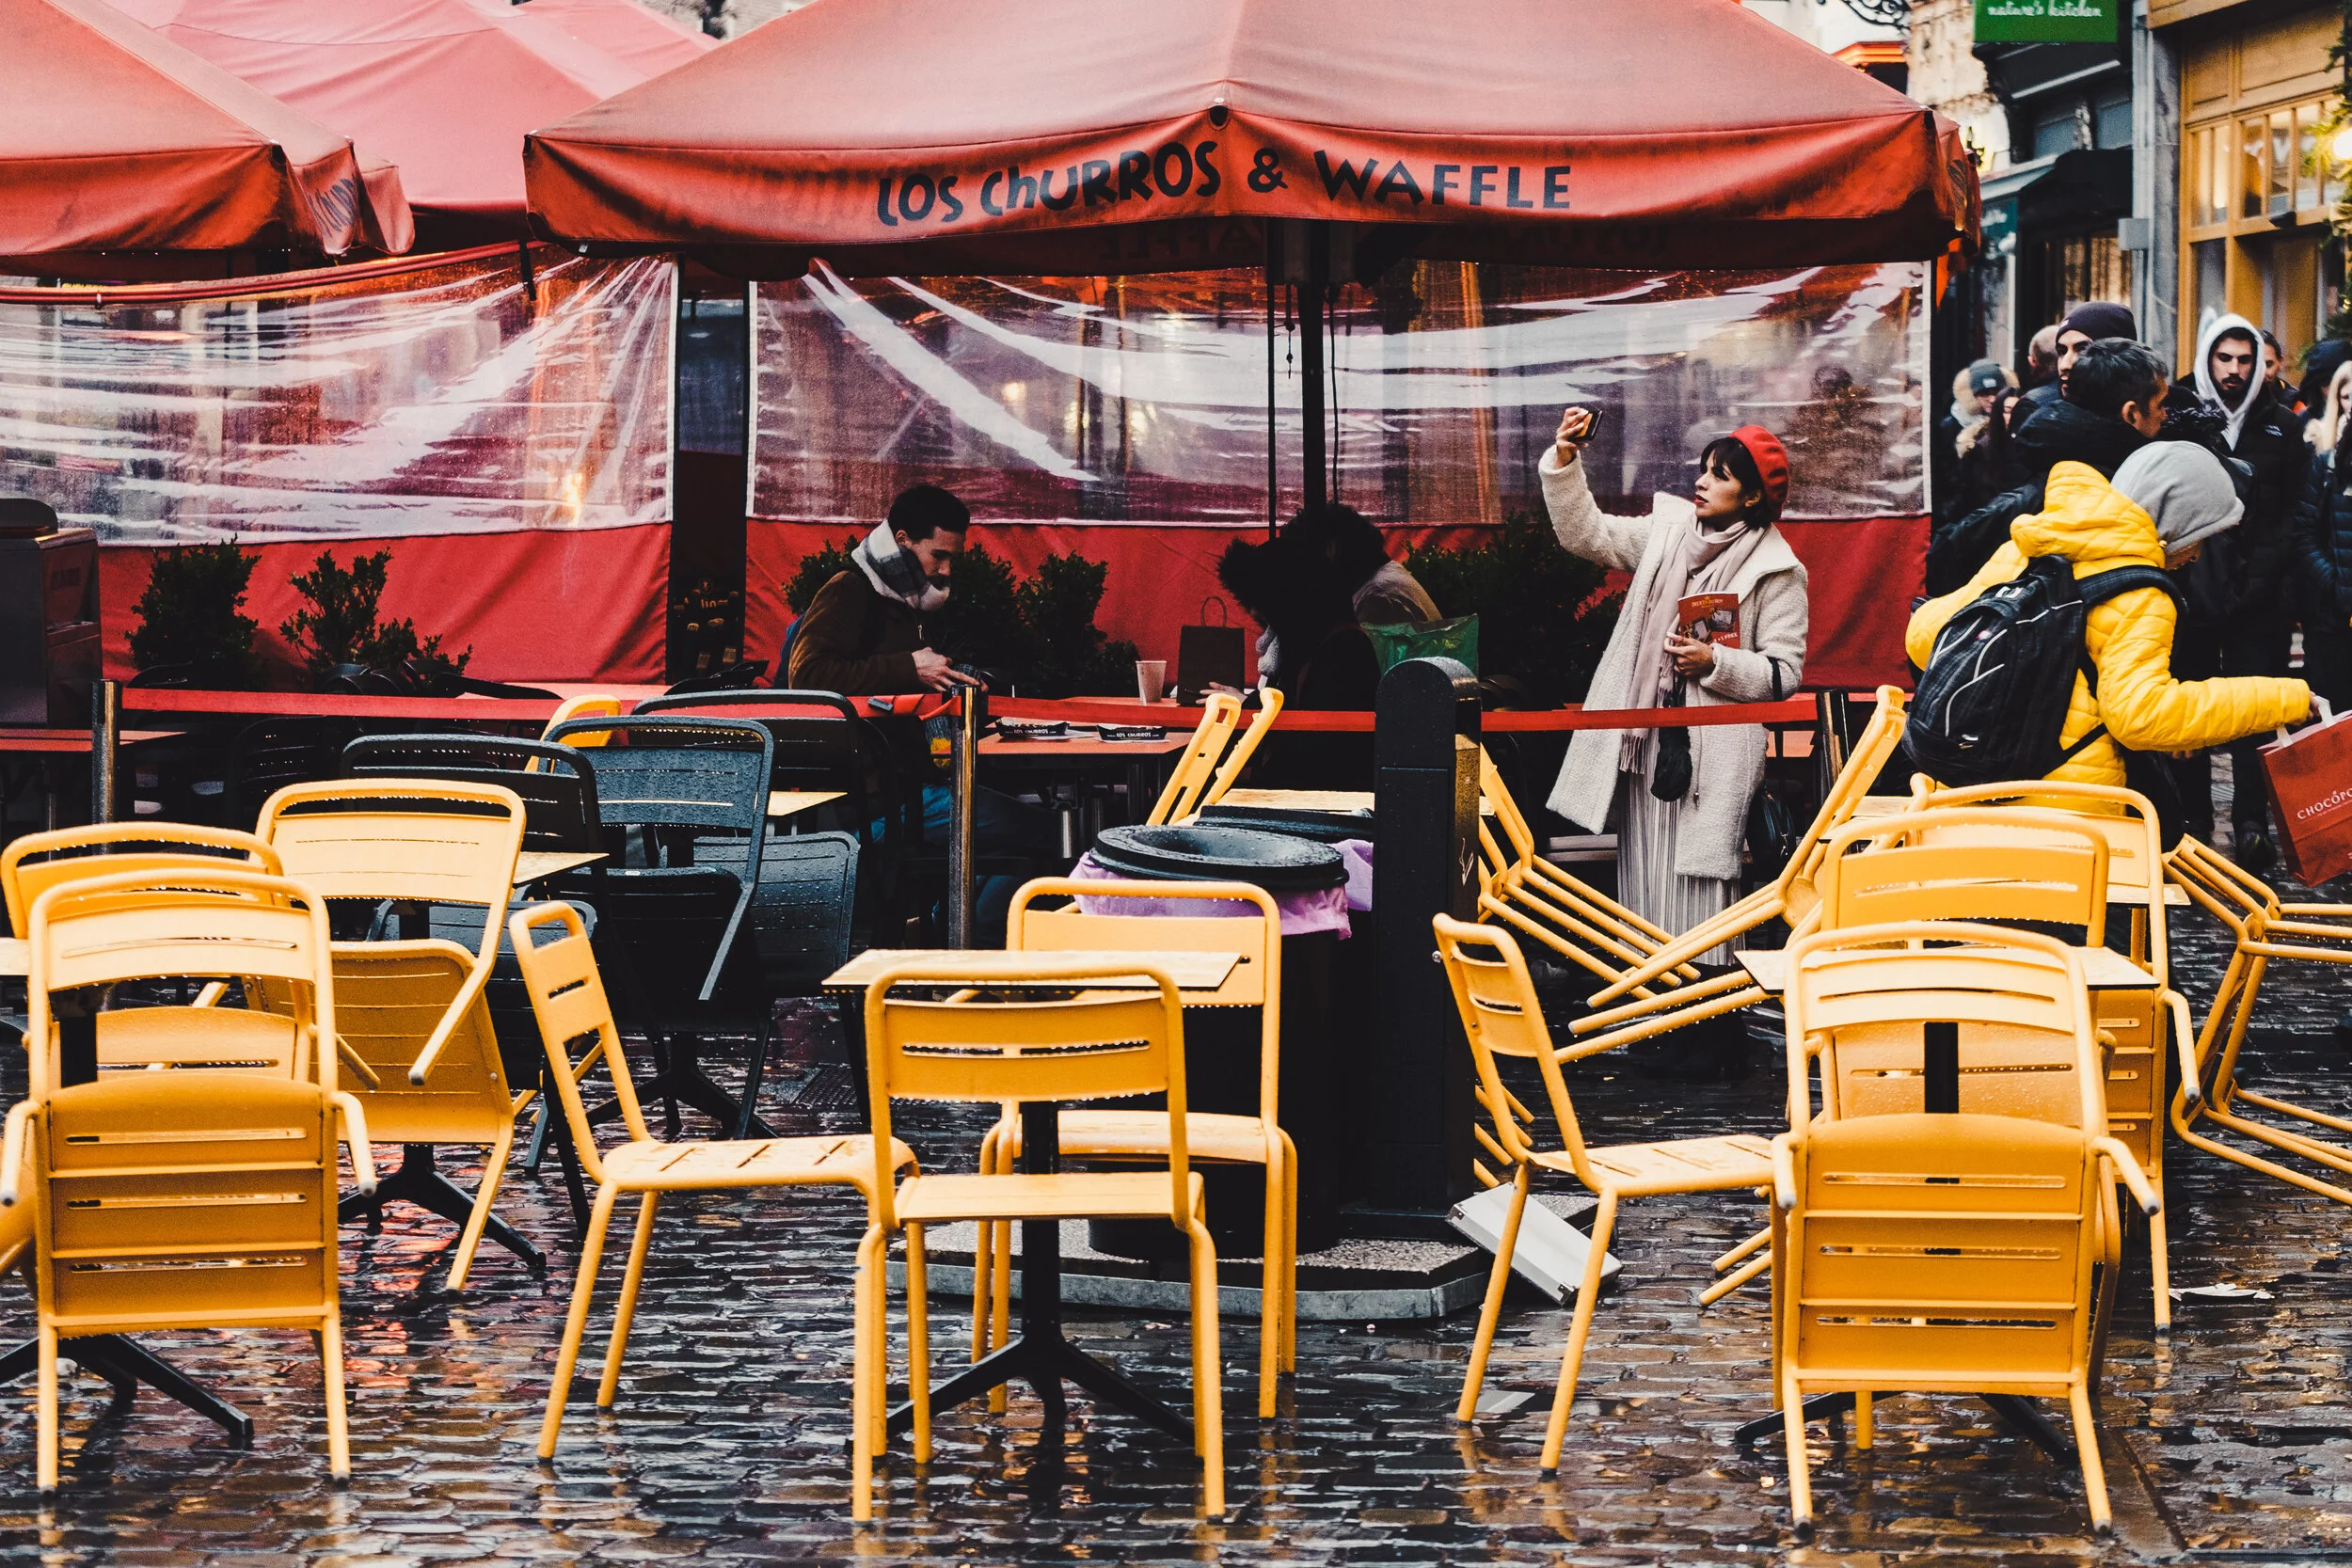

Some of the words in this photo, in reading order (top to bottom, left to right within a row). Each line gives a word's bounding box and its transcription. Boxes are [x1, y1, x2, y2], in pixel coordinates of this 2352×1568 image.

[877, 173, 963, 227] LOS
[1248, 147, 1288, 190] &
[1314, 148, 1571, 211] WAFFLE
